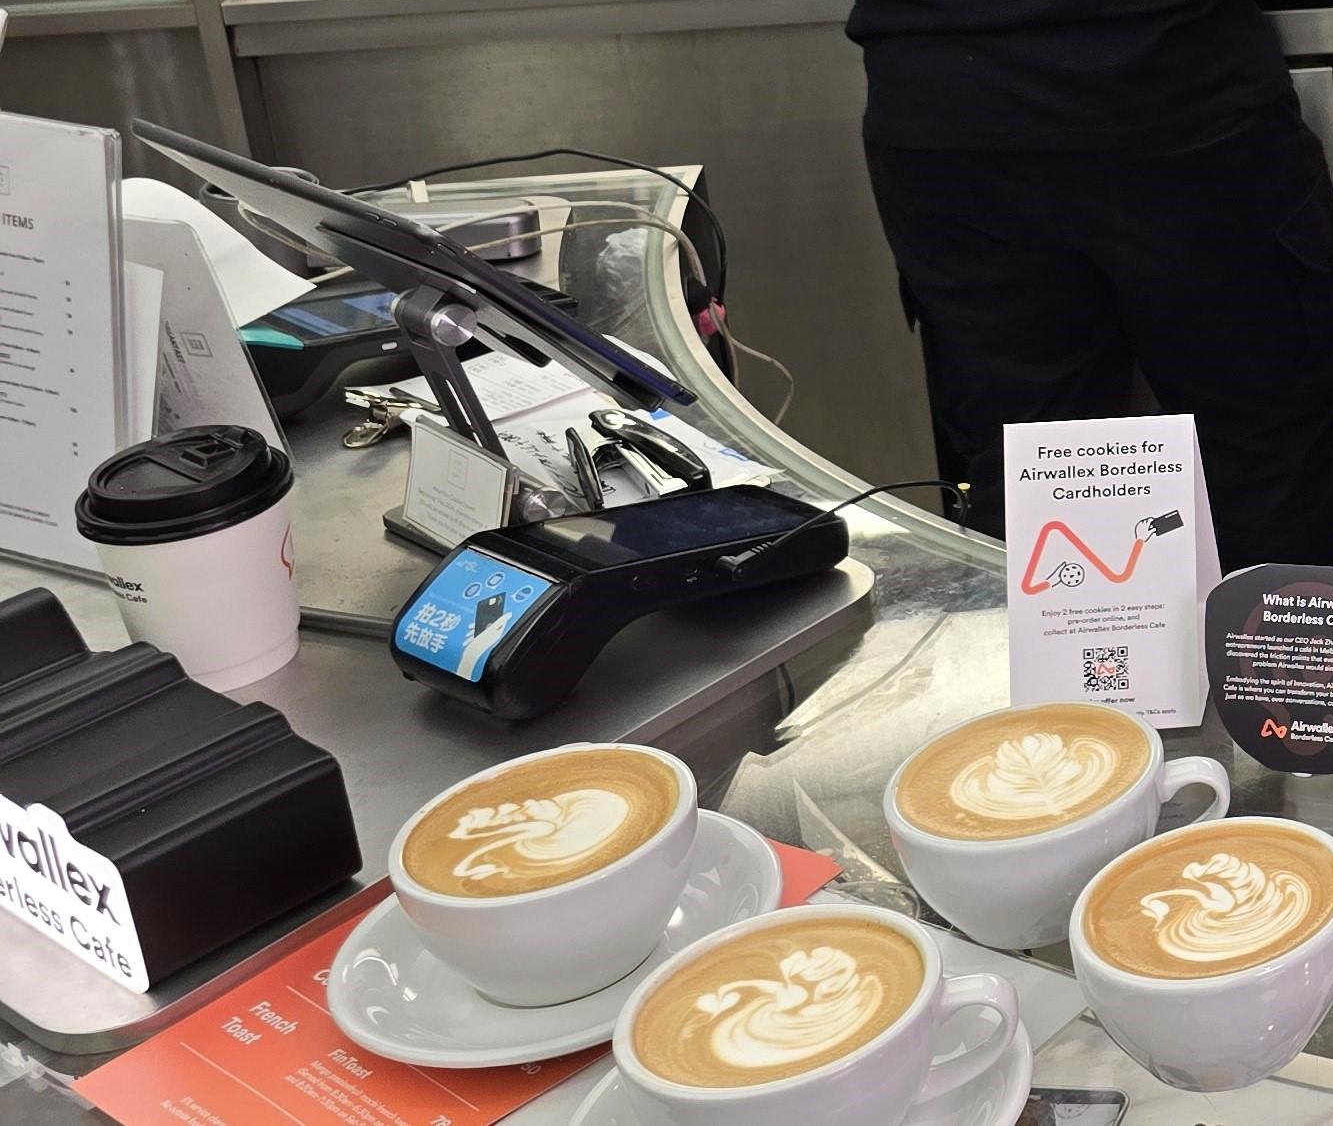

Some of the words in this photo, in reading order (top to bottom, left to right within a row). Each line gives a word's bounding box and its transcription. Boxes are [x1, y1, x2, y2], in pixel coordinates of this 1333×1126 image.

[2, 213, 34, 230] ITEMS
[1038, 446, 1072, 459] Free
[1076, 441, 1137, 457] cookies
[1142, 440, 1164, 454] for
[1019, 465, 1095, 482] Airwallex
[1100, 460, 1183, 477] Borderless
[1053, 483, 1151, 500] Cardholders
[126, 593, 148, 603] Cafe
[1262, 593, 1294, 607] What
[1296, 595, 1307, 608] is
[414, 602, 462, 632] 拍2秒
[1042, 610, 1061, 618] Enjoy
[1085, 606, 1111, 614] cookies
[1127, 604, 1143, 612] easy
[1263, 610, 1324, 625] Borderless
[404, 621, 448, 653] 先放手
[1078, 625, 1110, 634] Airwallex
[1112, 623, 1148, 632] Borderless
[70, 915, 132, 978] Cafe
[249, 1001, 298, 1035] French
[221, 1016, 263, 1045] Toast
[328, 1048, 373, 1080] FinToast
